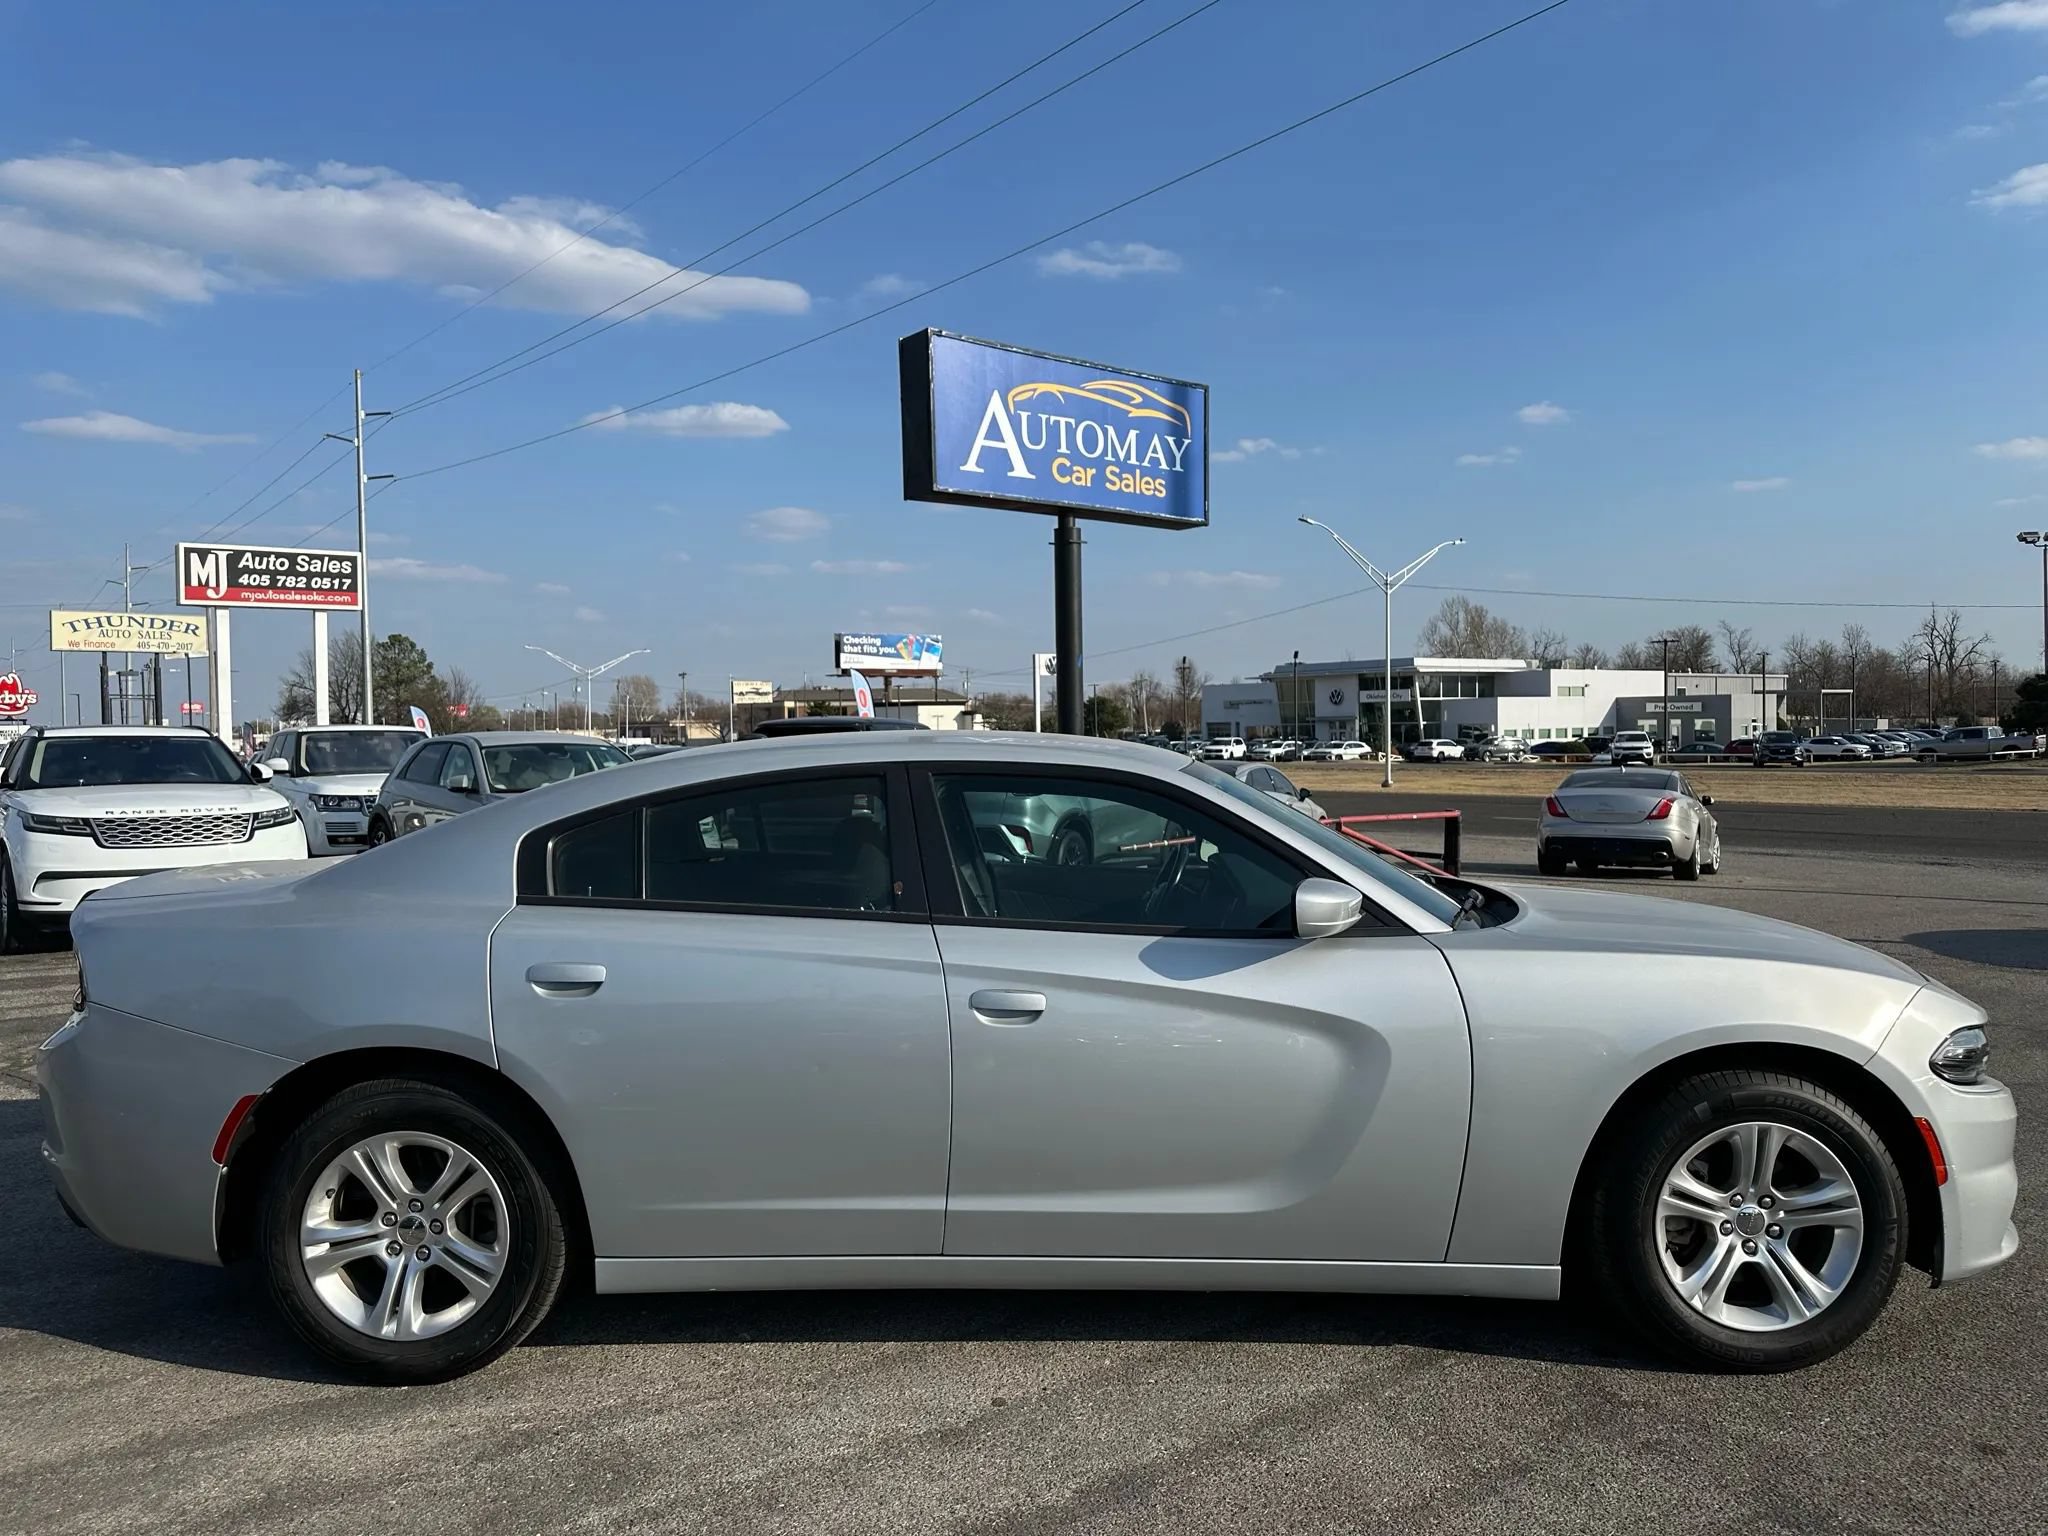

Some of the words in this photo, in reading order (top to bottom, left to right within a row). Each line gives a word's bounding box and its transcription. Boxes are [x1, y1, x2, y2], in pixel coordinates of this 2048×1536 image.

[959, 389, 1192, 480] AUTOMAY
[1052, 456, 1096, 487] Car
[1104, 465, 1167, 498] Sales
[238, 552, 289, 571] Auto
[296, 555, 352, 574] Sales
[190, 550, 234, 599] MJ
[238, 574, 270, 586] 405
[276, 575, 306, 588] 782
[311, 577, 351, 590] 0517
[241, 590, 352, 603] mjautosalesokc.com
[62, 615, 200, 637] THUNDER
[98, 629, 131, 639] AUTO
[137, 630, 172, 640] SALES
[843, 635, 882, 646] Checking
[68, 640, 80, 648] We
[84, 640, 116, 649] Finance
[137, 641, 193, 650] 405-470-2017
[843, 645, 861, 653] that
[863, 645, 877, 653] fits
[879, 647, 897, 655] you.
[180, 806, 238, 814] ROVER
